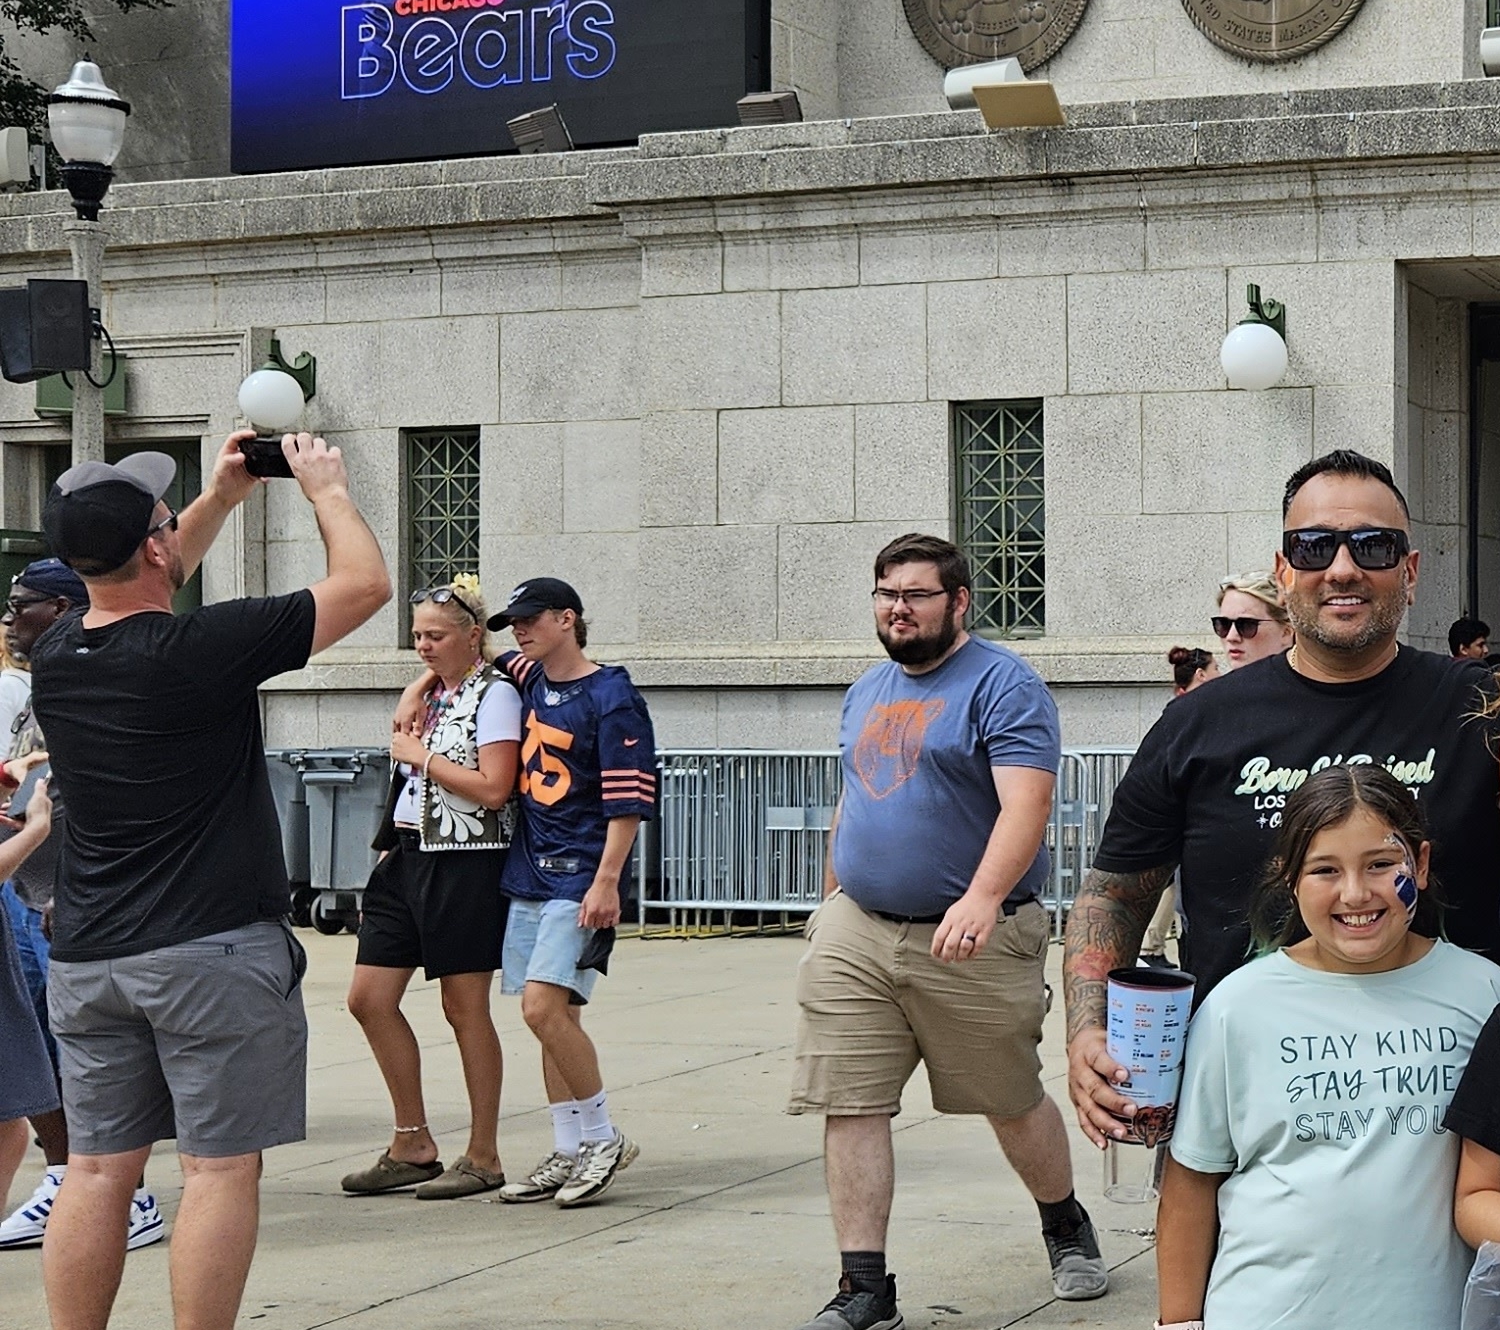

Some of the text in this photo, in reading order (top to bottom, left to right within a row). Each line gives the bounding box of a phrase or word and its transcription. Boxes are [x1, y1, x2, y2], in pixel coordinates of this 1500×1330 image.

[341, 0, 616, 100] Bears
[1222, 19, 1273, 44] STATES
[1234, 756, 1309, 796] Born
[1254, 795, 1286, 810] LOS
[1280, 1027, 1458, 1064] STAY KIND
[1286, 1064, 1456, 1104] STAY TRUE
[1295, 1104, 1450, 1143] STAY YOU
